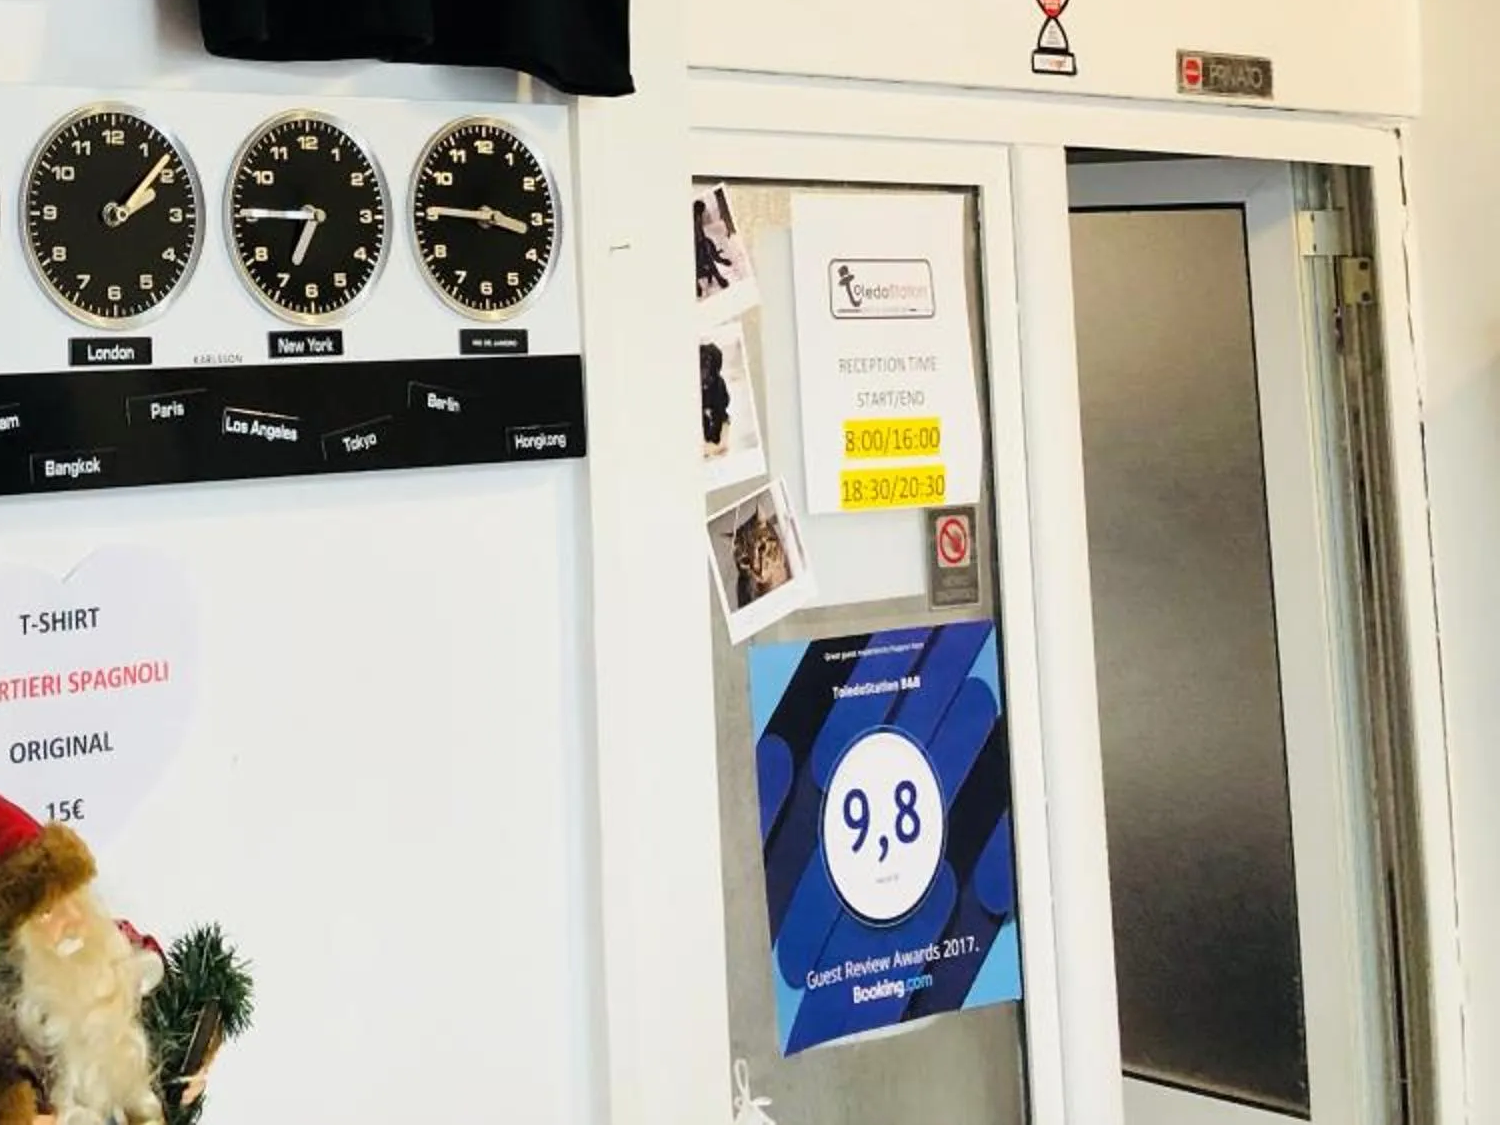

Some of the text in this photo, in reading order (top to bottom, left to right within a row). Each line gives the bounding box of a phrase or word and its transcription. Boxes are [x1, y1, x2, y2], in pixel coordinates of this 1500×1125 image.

[101, 130, 125, 145] 12
[296, 135, 319, 150] 12
[71, 140, 91, 156] 11
[139, 142, 149, 158] 1
[269, 146, 288, 160] 11
[330, 147, 341, 162] 1
[473, 139, 494, 155] 12
[448, 148, 467, 164] 11
[504, 152, 514, 167] 1
[50, 165, 75, 181] 10
[160, 168, 175, 184] 2
[251, 170, 274, 185] 10
[350, 172, 365, 186] 2
[432, 171, 453, 186] 10
[523, 176, 537, 191] 2
[42, 204, 57, 220] 9
[169, 207, 183, 223] 3
[359, 209, 373, 224] 3
[530, 212, 543, 227] 3
[51, 246, 67, 262] 8
[161, 247, 177, 262] 4
[254, 246, 269, 262] 8
[353, 246, 367, 261] 4
[434, 244, 447, 259] 8
[525, 248, 538, 262] 4
[76, 274, 91, 290] 7
[139, 274, 154, 290] 5
[276, 272, 291, 288] 7
[333, 272, 347, 288] 5
[454, 270, 467, 284] 7
[507, 272, 519, 286] 5
[107, 285, 122, 301] 6
[305, 283, 319, 298] 6
[480, 281, 493, 296] 6
[86, 344, 135, 361] London
[277, 336, 334, 354] New York
[838, 355, 938, 375] RECEPTION TIME
[426, 392, 461, 413] Berlin
[856, 389, 926, 410] START/END
[150, 401, 185, 420] Paris
[224, 419, 298, 443] Los Angeles
[342, 431, 378, 453] Tokyo
[514, 431, 567, 451] Hongkong
[844, 426, 941, 454] 8:00/16:00
[44, 456, 102, 478] Bangkok
[842, 474, 946, 504] 18:30/20:30
[19, 606, 101, 635] T-SHIRT
[67, 660, 170, 695] SPAGNOLI
[9, 730, 115, 765] ORIGINAL
[46, 798, 86, 823] 15€
[843, 778, 922, 863] 9,8
[805, 965, 842, 991] Guest
[844, 954, 891, 979] Review
[892, 942, 941, 969] Awards
[852, 972, 934, 1005] Booking.com
